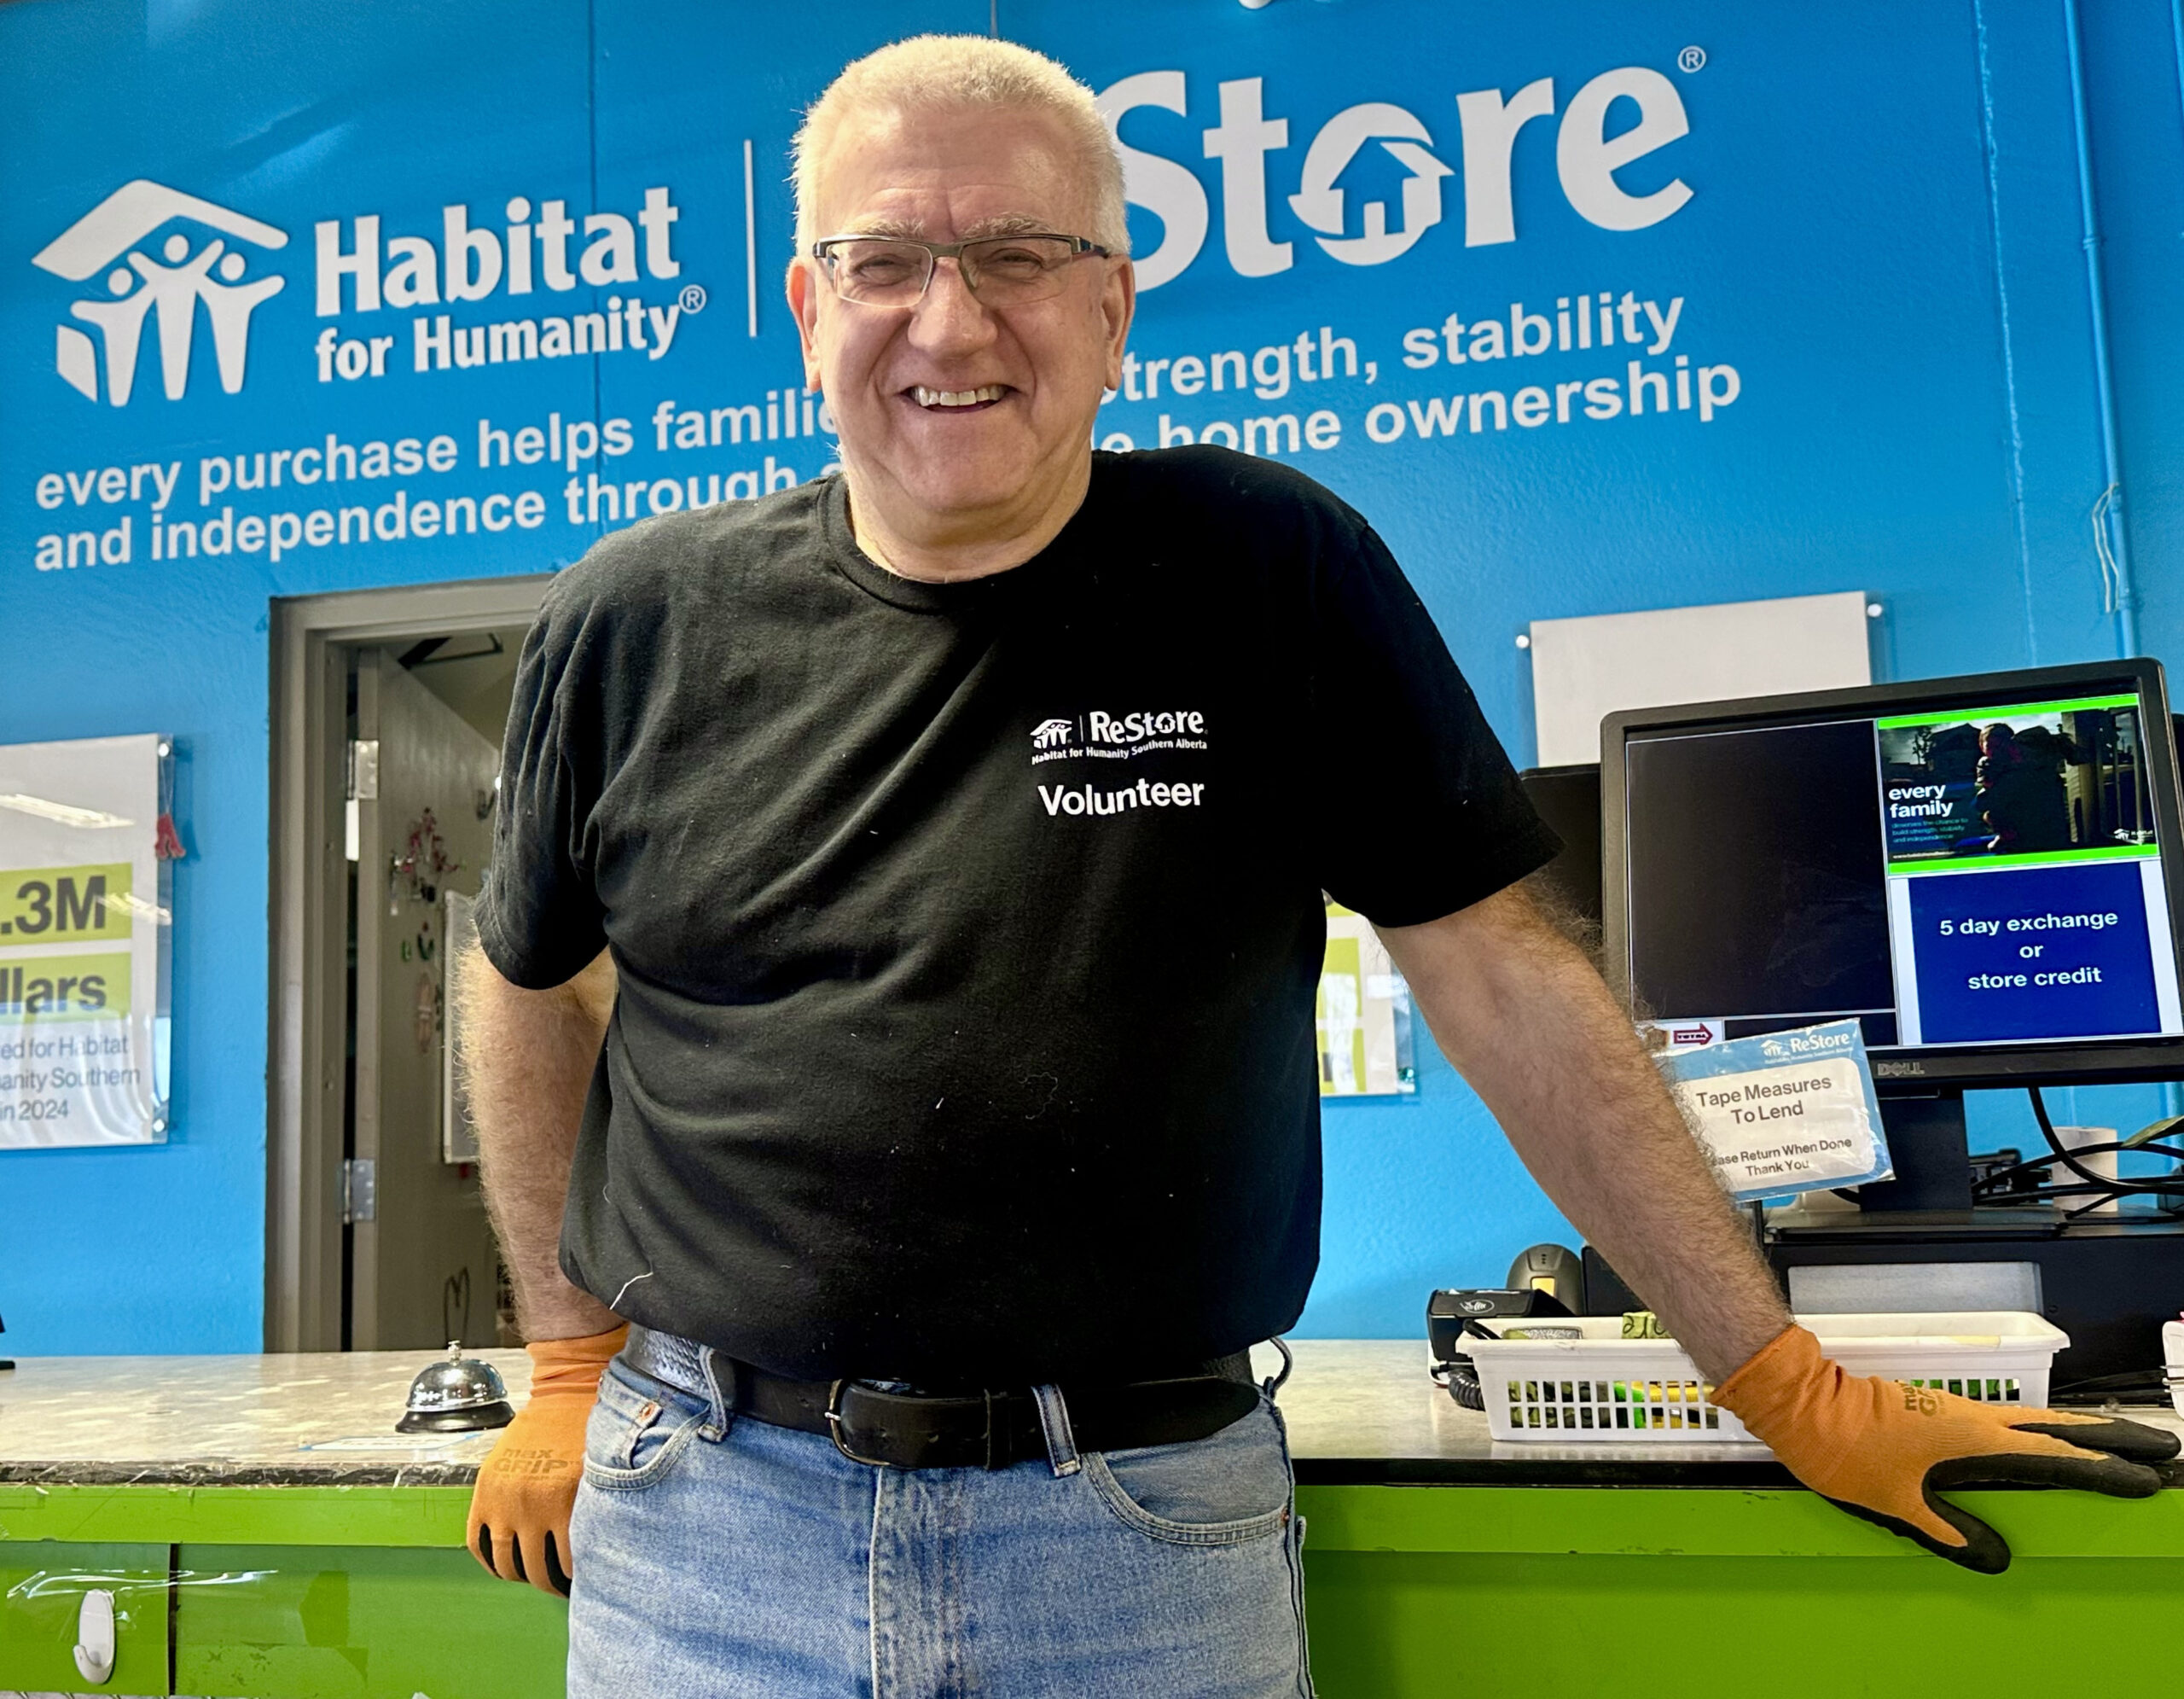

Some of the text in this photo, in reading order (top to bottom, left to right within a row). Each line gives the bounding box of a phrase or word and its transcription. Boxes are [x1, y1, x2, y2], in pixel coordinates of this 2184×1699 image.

[315, 187, 680, 317] Habitat
[315, 327, 393, 382] for
[36, 461, 182, 511] every
[200, 433, 458, 506] purchase
[479, 412, 634, 473] helps
[1101, 326, 1378, 406] trength,
[1403, 291, 1684, 369] stability
[34, 515, 131, 572] and
[151, 491, 546, 562] independence
[1159, 409, 1342, 457] home
[1364, 355, 1740, 444] ownership
[1089, 711, 1204, 744] ReStore
[1031, 738, 1207, 765] Habitat for Humanity Southern Alberta
[1037, 777, 1205, 817] Volunteer
[1888, 784, 1946, 800] every
[1890, 800, 1954, 818] family
[1940, 912, 2118, 937] 5 day exchange
[2019, 945, 2044, 958] or
[1967, 966, 2103, 990] store credit
[28, 1037, 55, 1058] for
[1790, 1033, 1850, 1053] ReStore
[50, 1066, 141, 1089] Southern
[1877, 1062, 1926, 1076] DELL
[1696, 1077, 1833, 1108] Tape Measures
[19, 1099, 69, 1121] 2024
[1730, 1100, 1804, 1124] To Lend
[1740, 1149, 1781, 1161] Return
[1781, 1143, 1817, 1155] When
[1819, 1138, 1852, 1150] Done
[1745, 1160, 1810, 1177] Thank You
